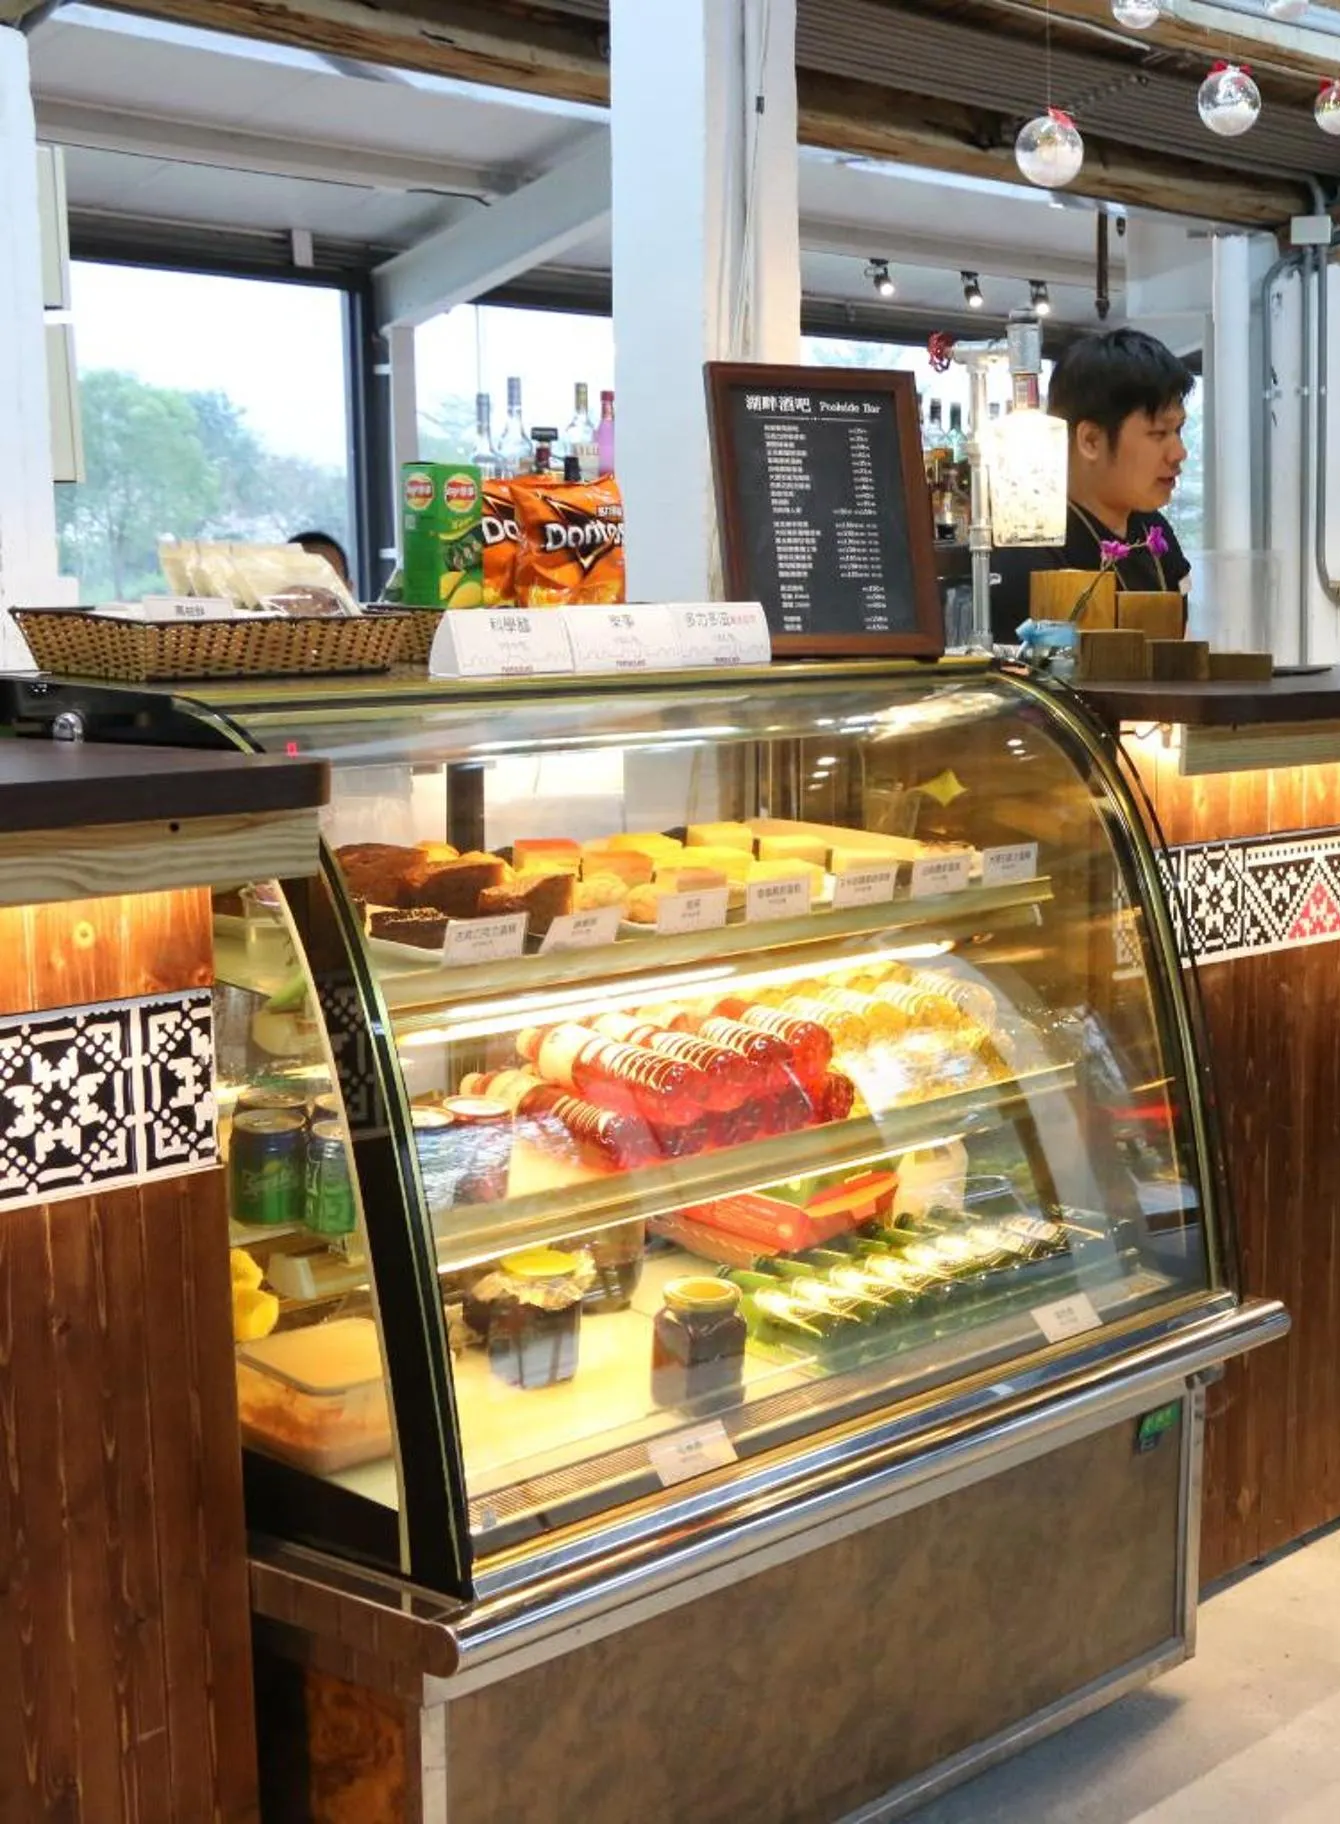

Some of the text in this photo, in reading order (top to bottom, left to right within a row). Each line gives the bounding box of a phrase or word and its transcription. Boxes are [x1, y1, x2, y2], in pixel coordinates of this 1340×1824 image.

[745, 395, 880, 414] 湖畔酒吧 Poolside Bar
